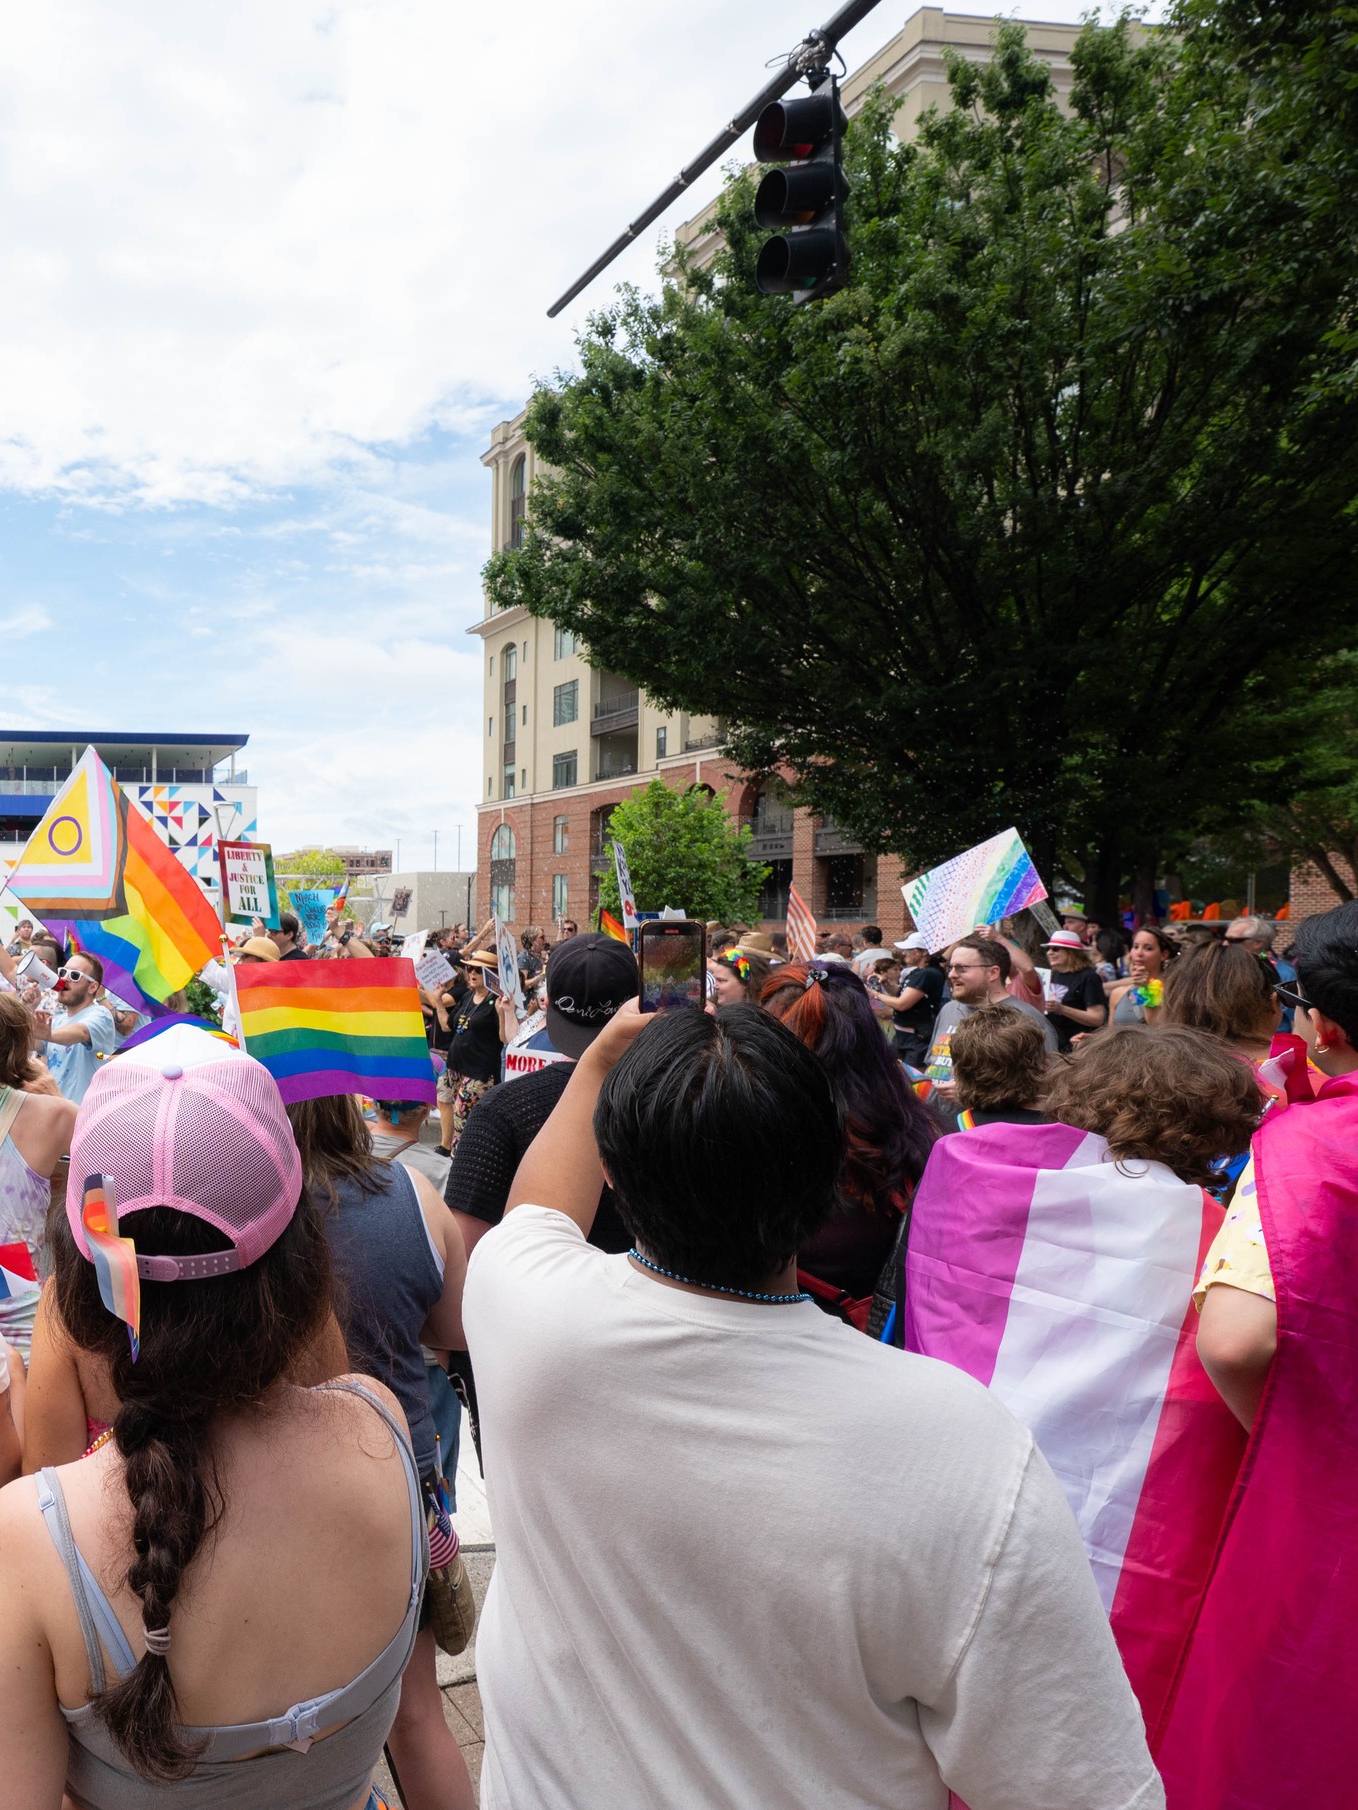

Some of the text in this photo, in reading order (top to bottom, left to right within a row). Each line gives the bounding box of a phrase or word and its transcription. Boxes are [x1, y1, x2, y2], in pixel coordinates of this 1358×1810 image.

[227, 850, 262, 861] LIBERTY
[242, 863, 248, 872] &
[229, 873, 264, 884] JUSTICE
[239, 884, 256, 895] FOR
[238, 896, 262, 912] ALL
[506, 1054, 546, 1072] MORE
[935, 1056, 953, 1066] BUT
